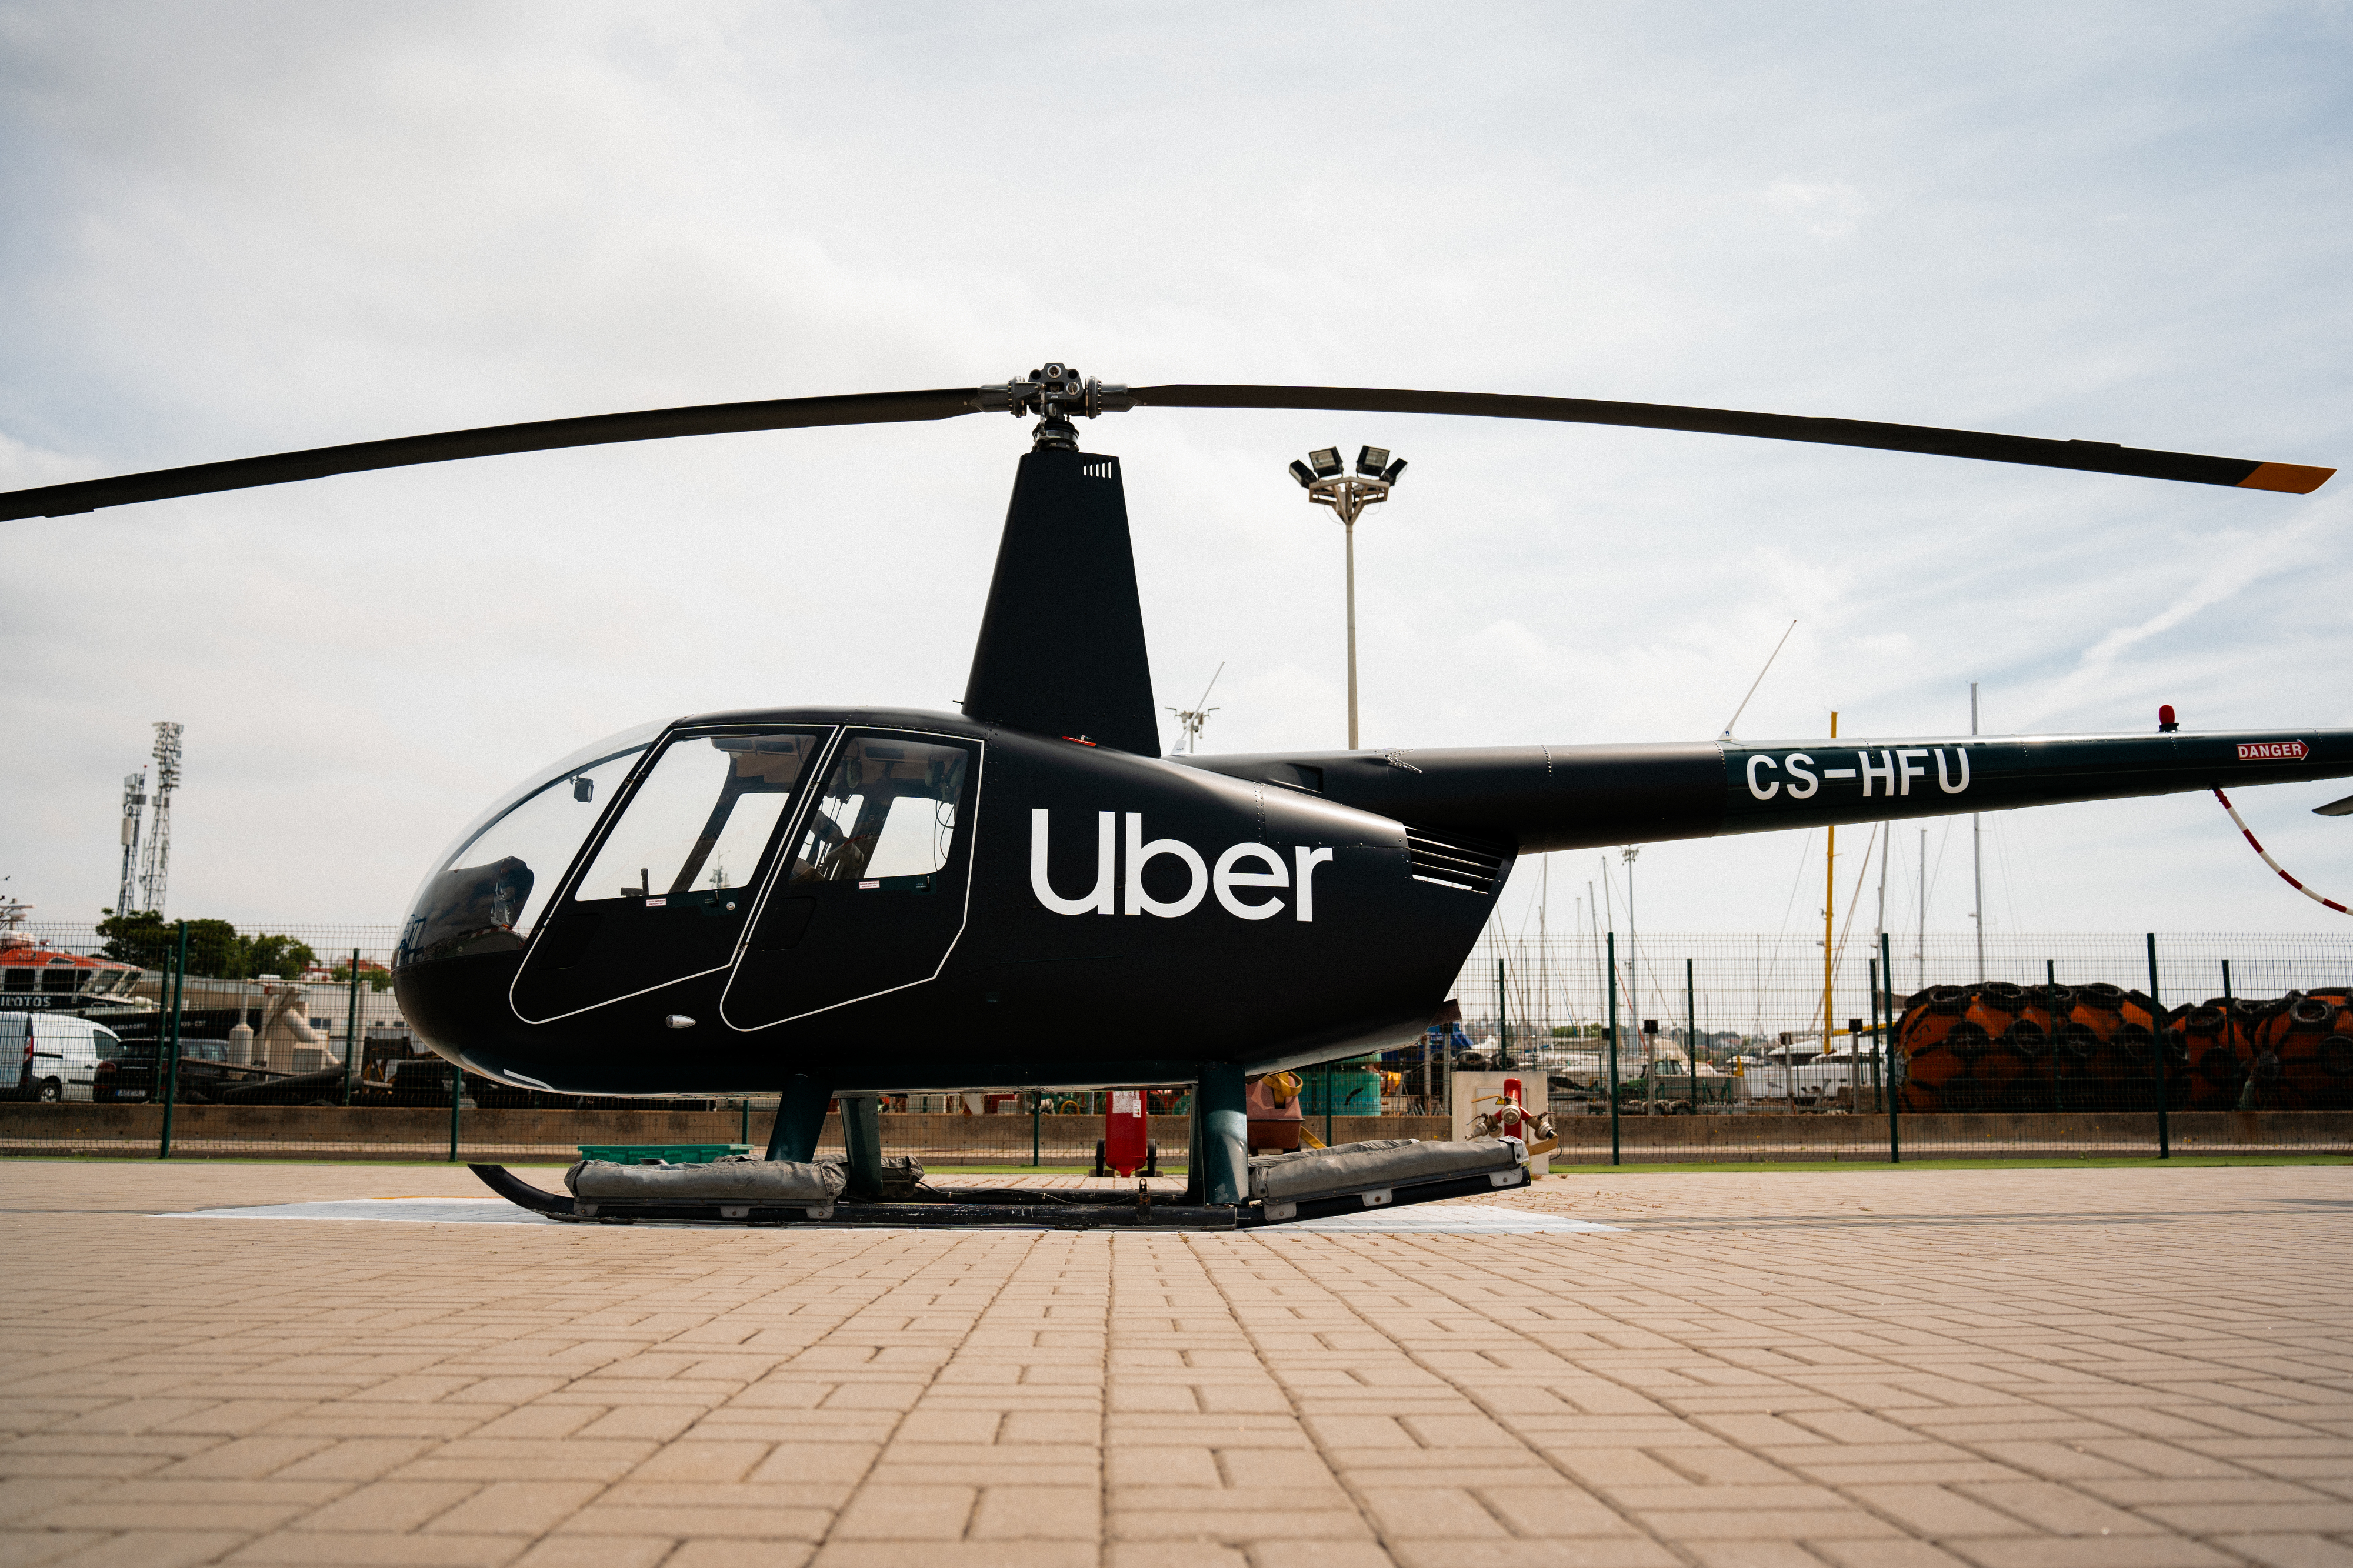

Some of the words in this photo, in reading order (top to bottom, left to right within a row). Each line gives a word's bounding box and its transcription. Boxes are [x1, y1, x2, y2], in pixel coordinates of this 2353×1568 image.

[1747, 748, 1970, 800] CS-HFU
[2238, 744, 2302, 758] DANGER
[1031, 809, 1333, 922] Uber
